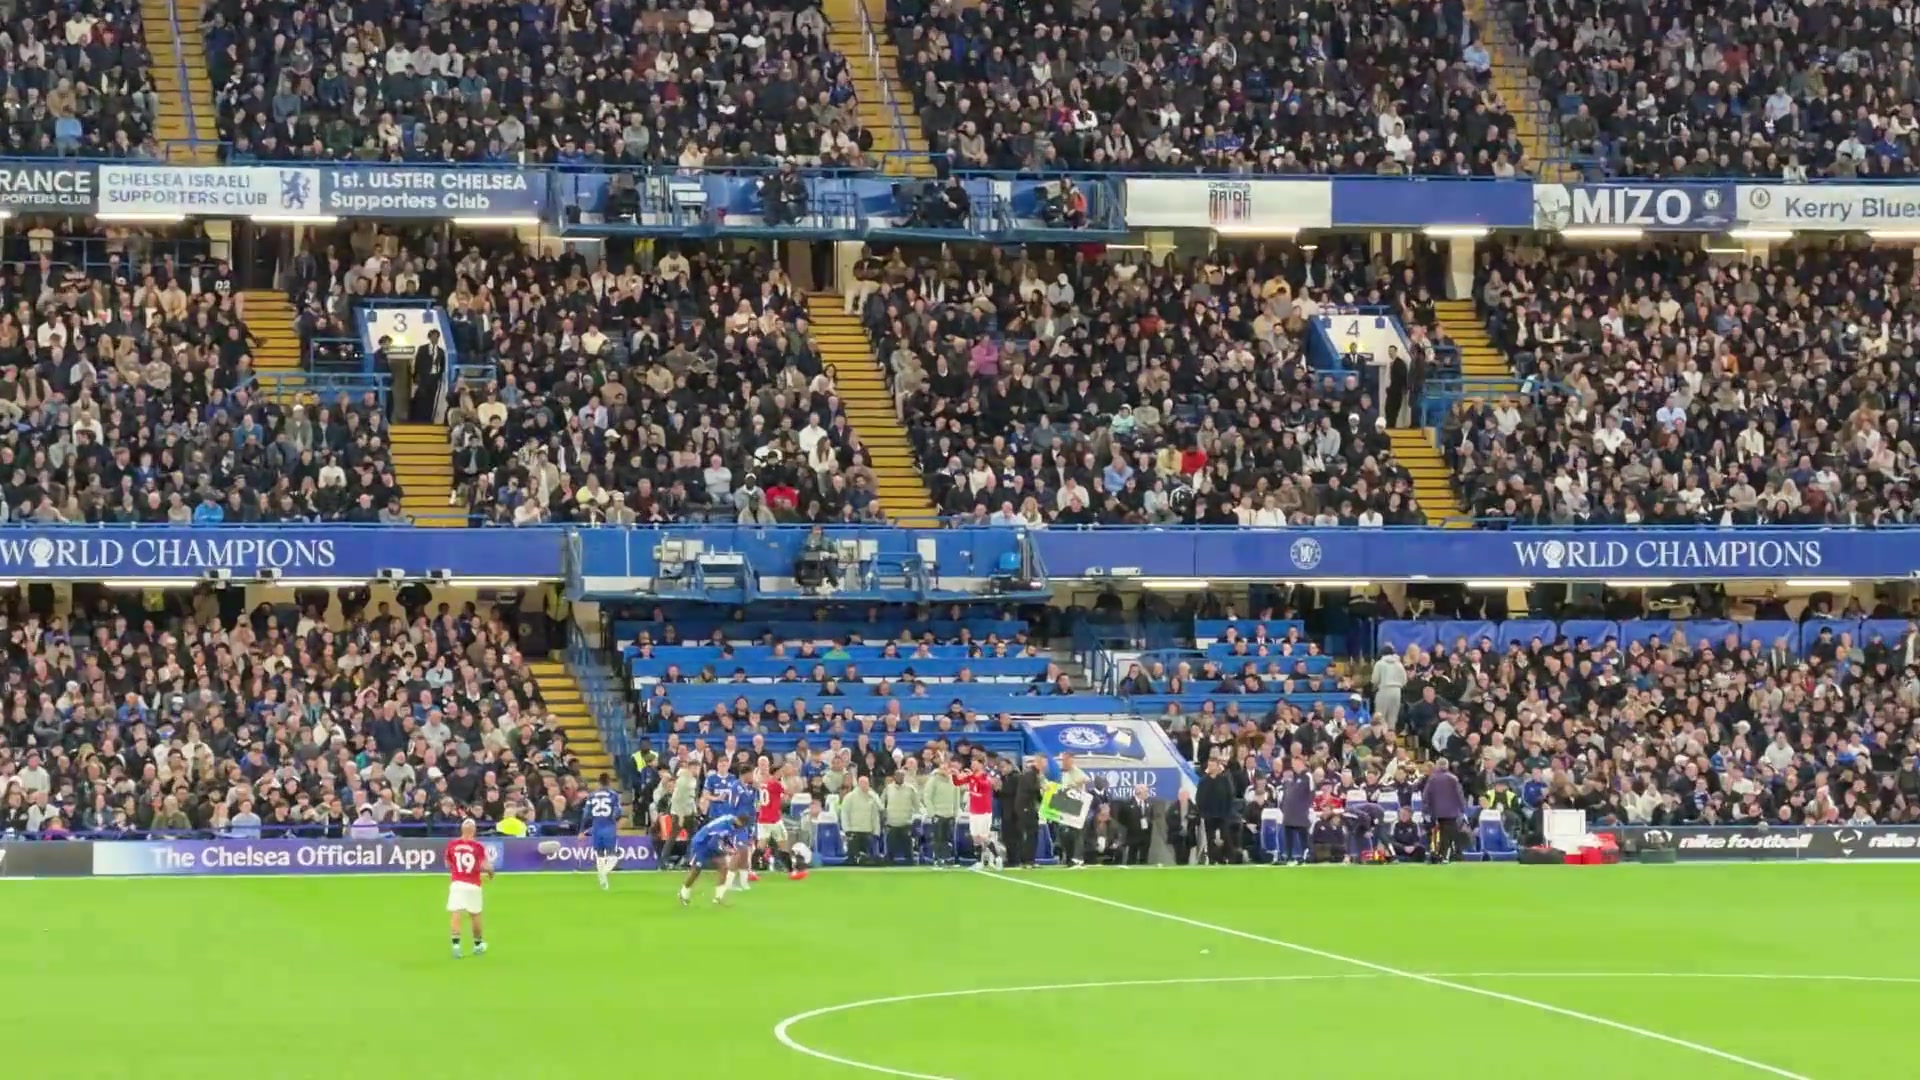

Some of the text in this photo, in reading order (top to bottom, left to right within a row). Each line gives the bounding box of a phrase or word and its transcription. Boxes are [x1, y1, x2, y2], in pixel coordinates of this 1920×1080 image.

[108, 172, 250, 190] CHELSEA ISRAELI
[332, 172, 527, 192] 1st. ULSTER CHELSEA
[58, 194, 91, 205] CLUB
[108, 190, 267, 206] SUPPORTERS CLUB
[331, 191, 490, 212] Supporters Club
[1573, 188, 1691, 225] MIZO
[1785, 197, 1853, 221] Kerry
[393, 313, 407, 332] 3
[1346, 320, 1360, 338] 4
[132, 539, 335, 567] CHAMPIONS
[1514, 540, 1822, 568] WORLD CHAMPIONS
[591, 797, 612, 817] 25
[1679, 834, 1814, 849] nike football
[1868, 834, 1916, 849] nike
[153, 848, 436, 872] The Chelsea Official App
[453, 852, 476, 874] 19
